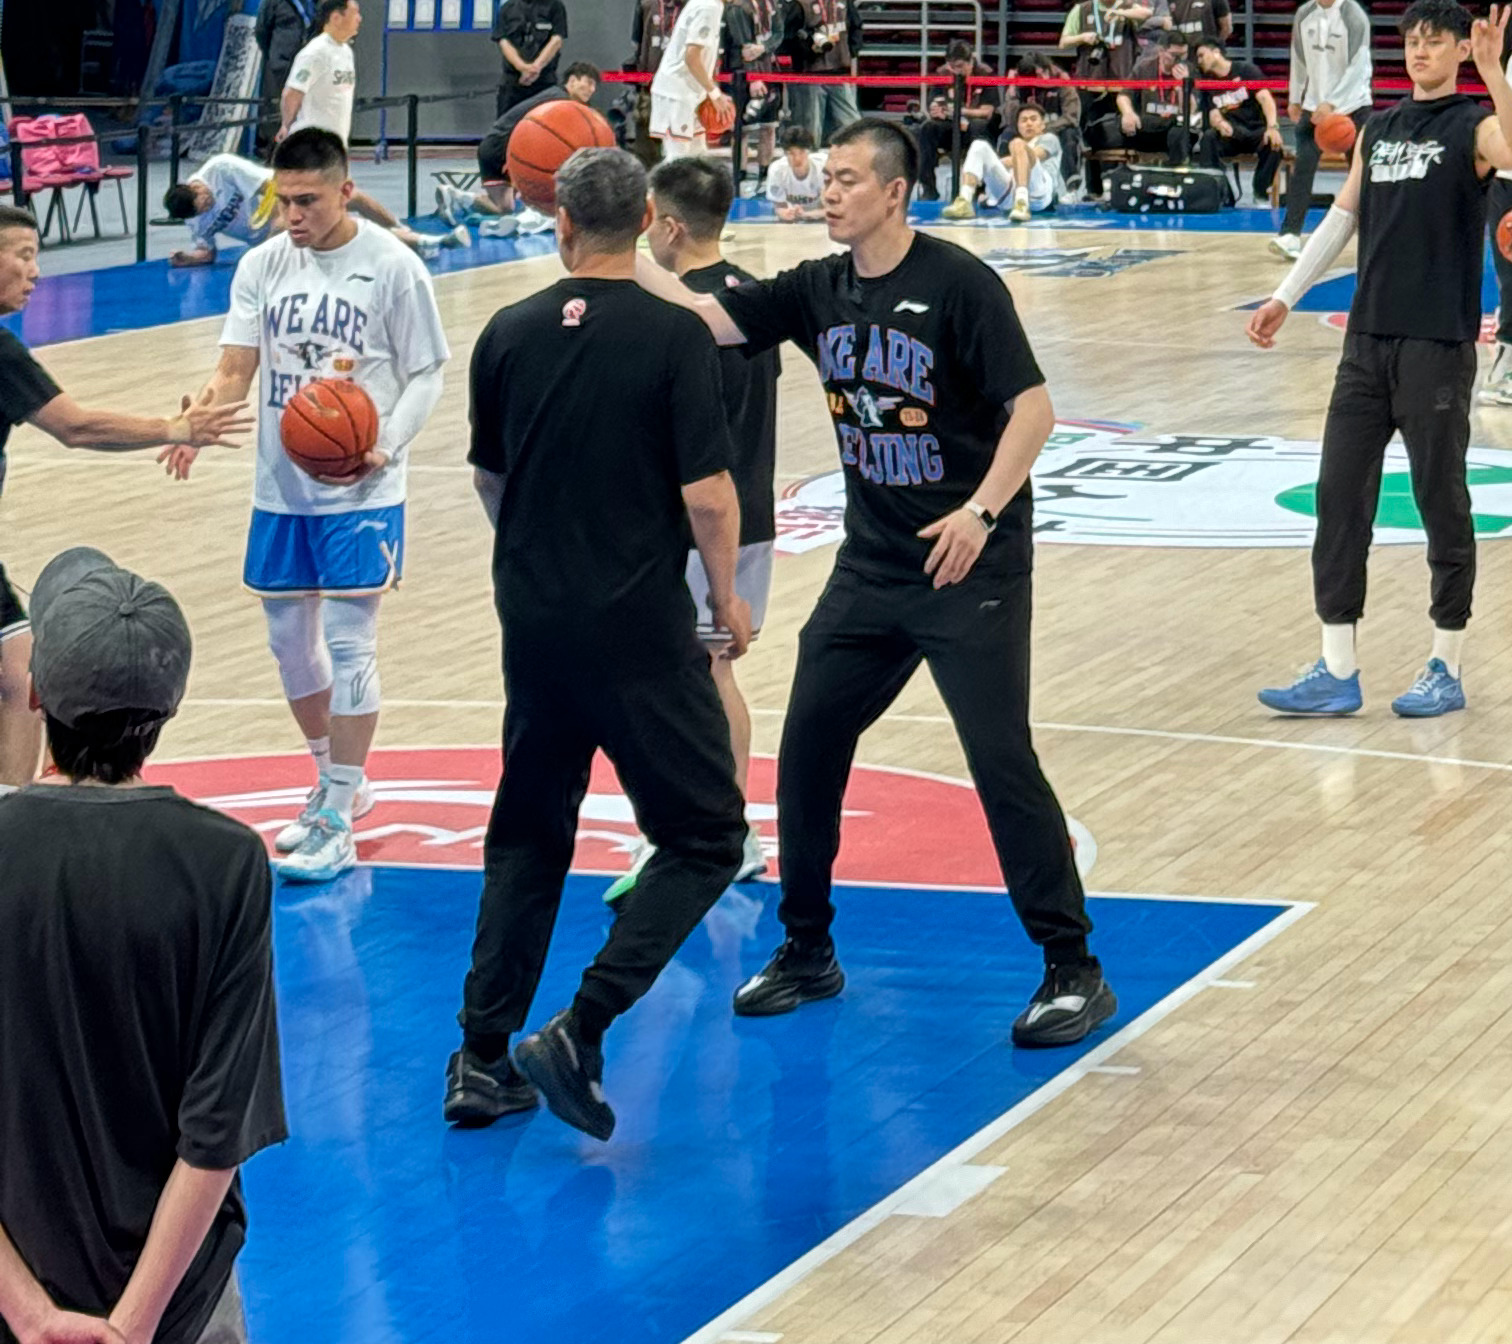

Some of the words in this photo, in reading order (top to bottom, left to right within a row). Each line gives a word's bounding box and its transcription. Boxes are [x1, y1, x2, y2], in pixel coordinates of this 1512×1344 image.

[263, 292, 309, 339] WE
[310, 293, 368, 355] ARE
[817, 324, 857, 383] WE
[862, 324, 936, 408] ARE
